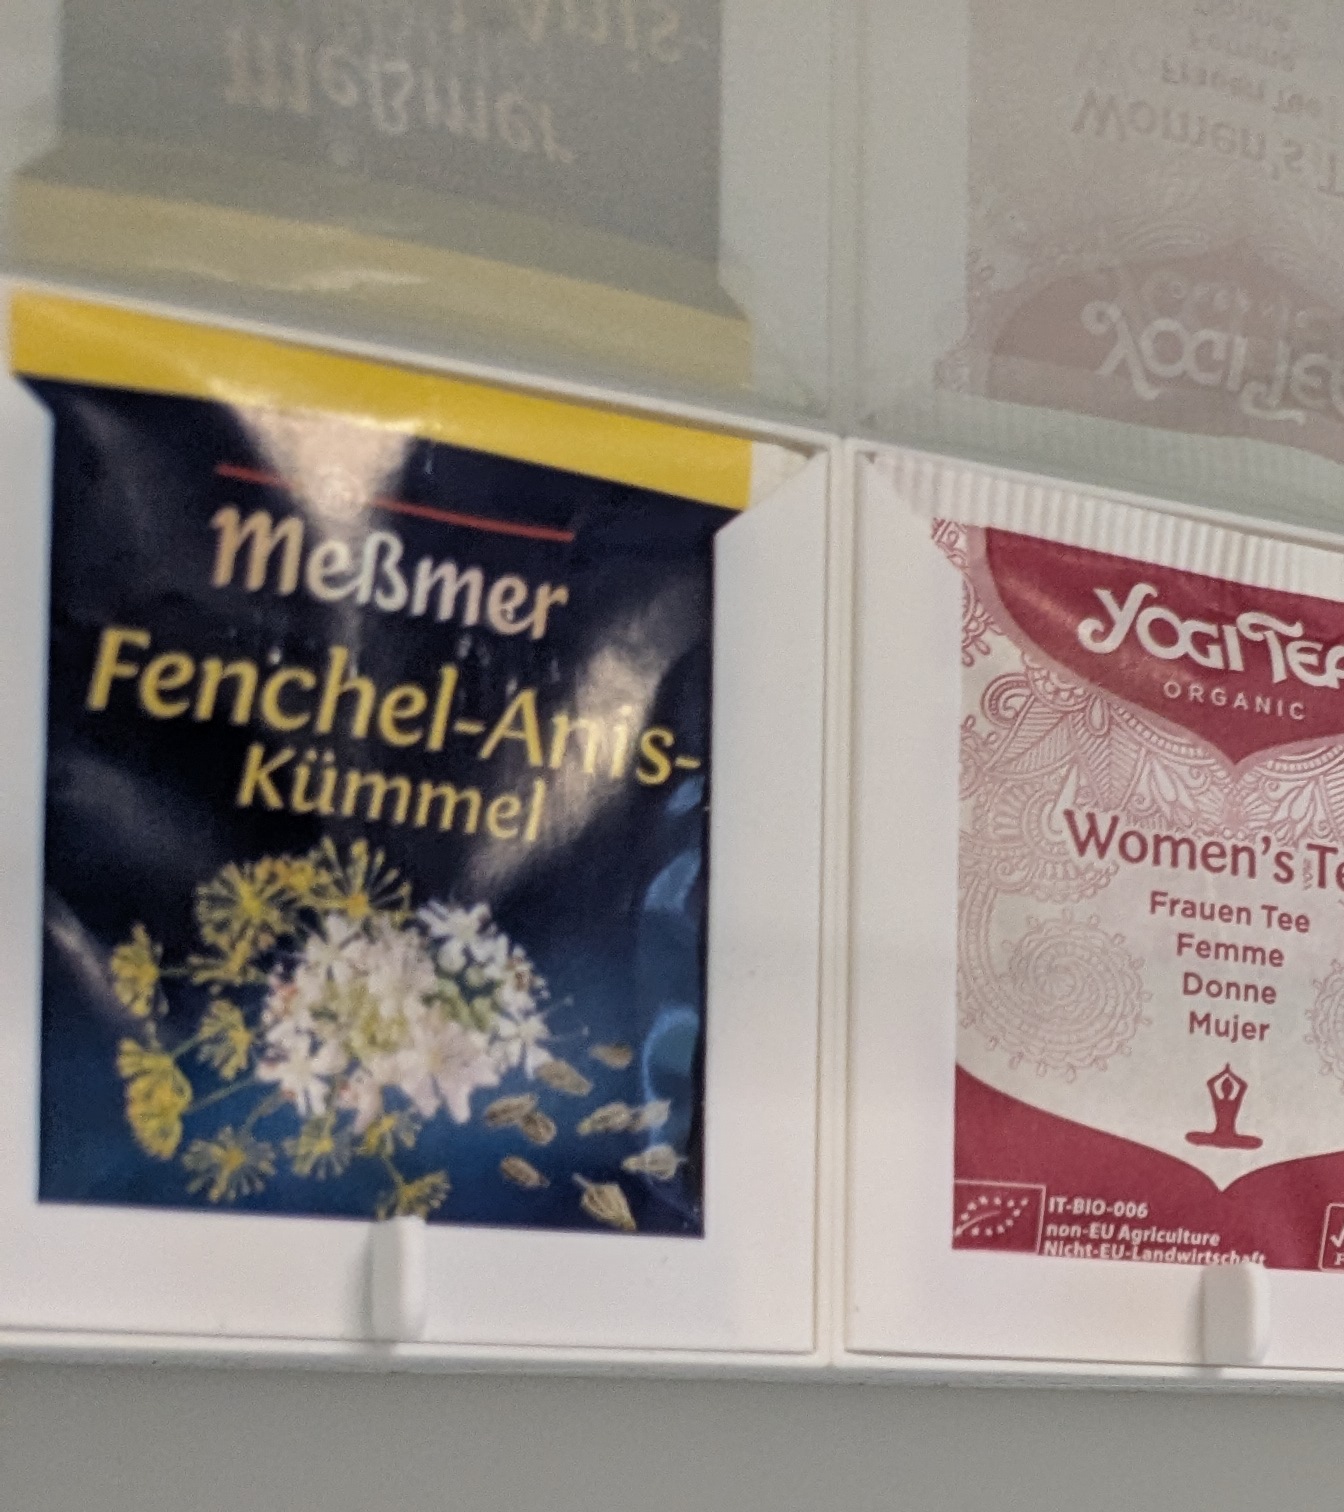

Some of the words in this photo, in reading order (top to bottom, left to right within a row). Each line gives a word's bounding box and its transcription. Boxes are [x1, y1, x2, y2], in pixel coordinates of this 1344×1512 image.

[210, 506, 569, 640] Meßmer
[86, 626, 703, 786] Fenchel-Anis-
[1162, 680, 1306, 721] ORGANIC
[236, 742, 547, 843] Kümmel
[1063, 808, 1296, 886] Women's
[1149, 891, 1252, 926] Frauen
[1261, 904, 1312, 933] Tee
[1176, 932, 1285, 968] Femme
[1182, 971, 1277, 1005] Donne
[1188, 1011, 1271, 1043] Mujer
[1048, 1196, 1149, 1219] IT-BIO-006
[1045, 1222, 1114, 1240] non-EU
[1118, 1225, 1221, 1247] Agriculture
